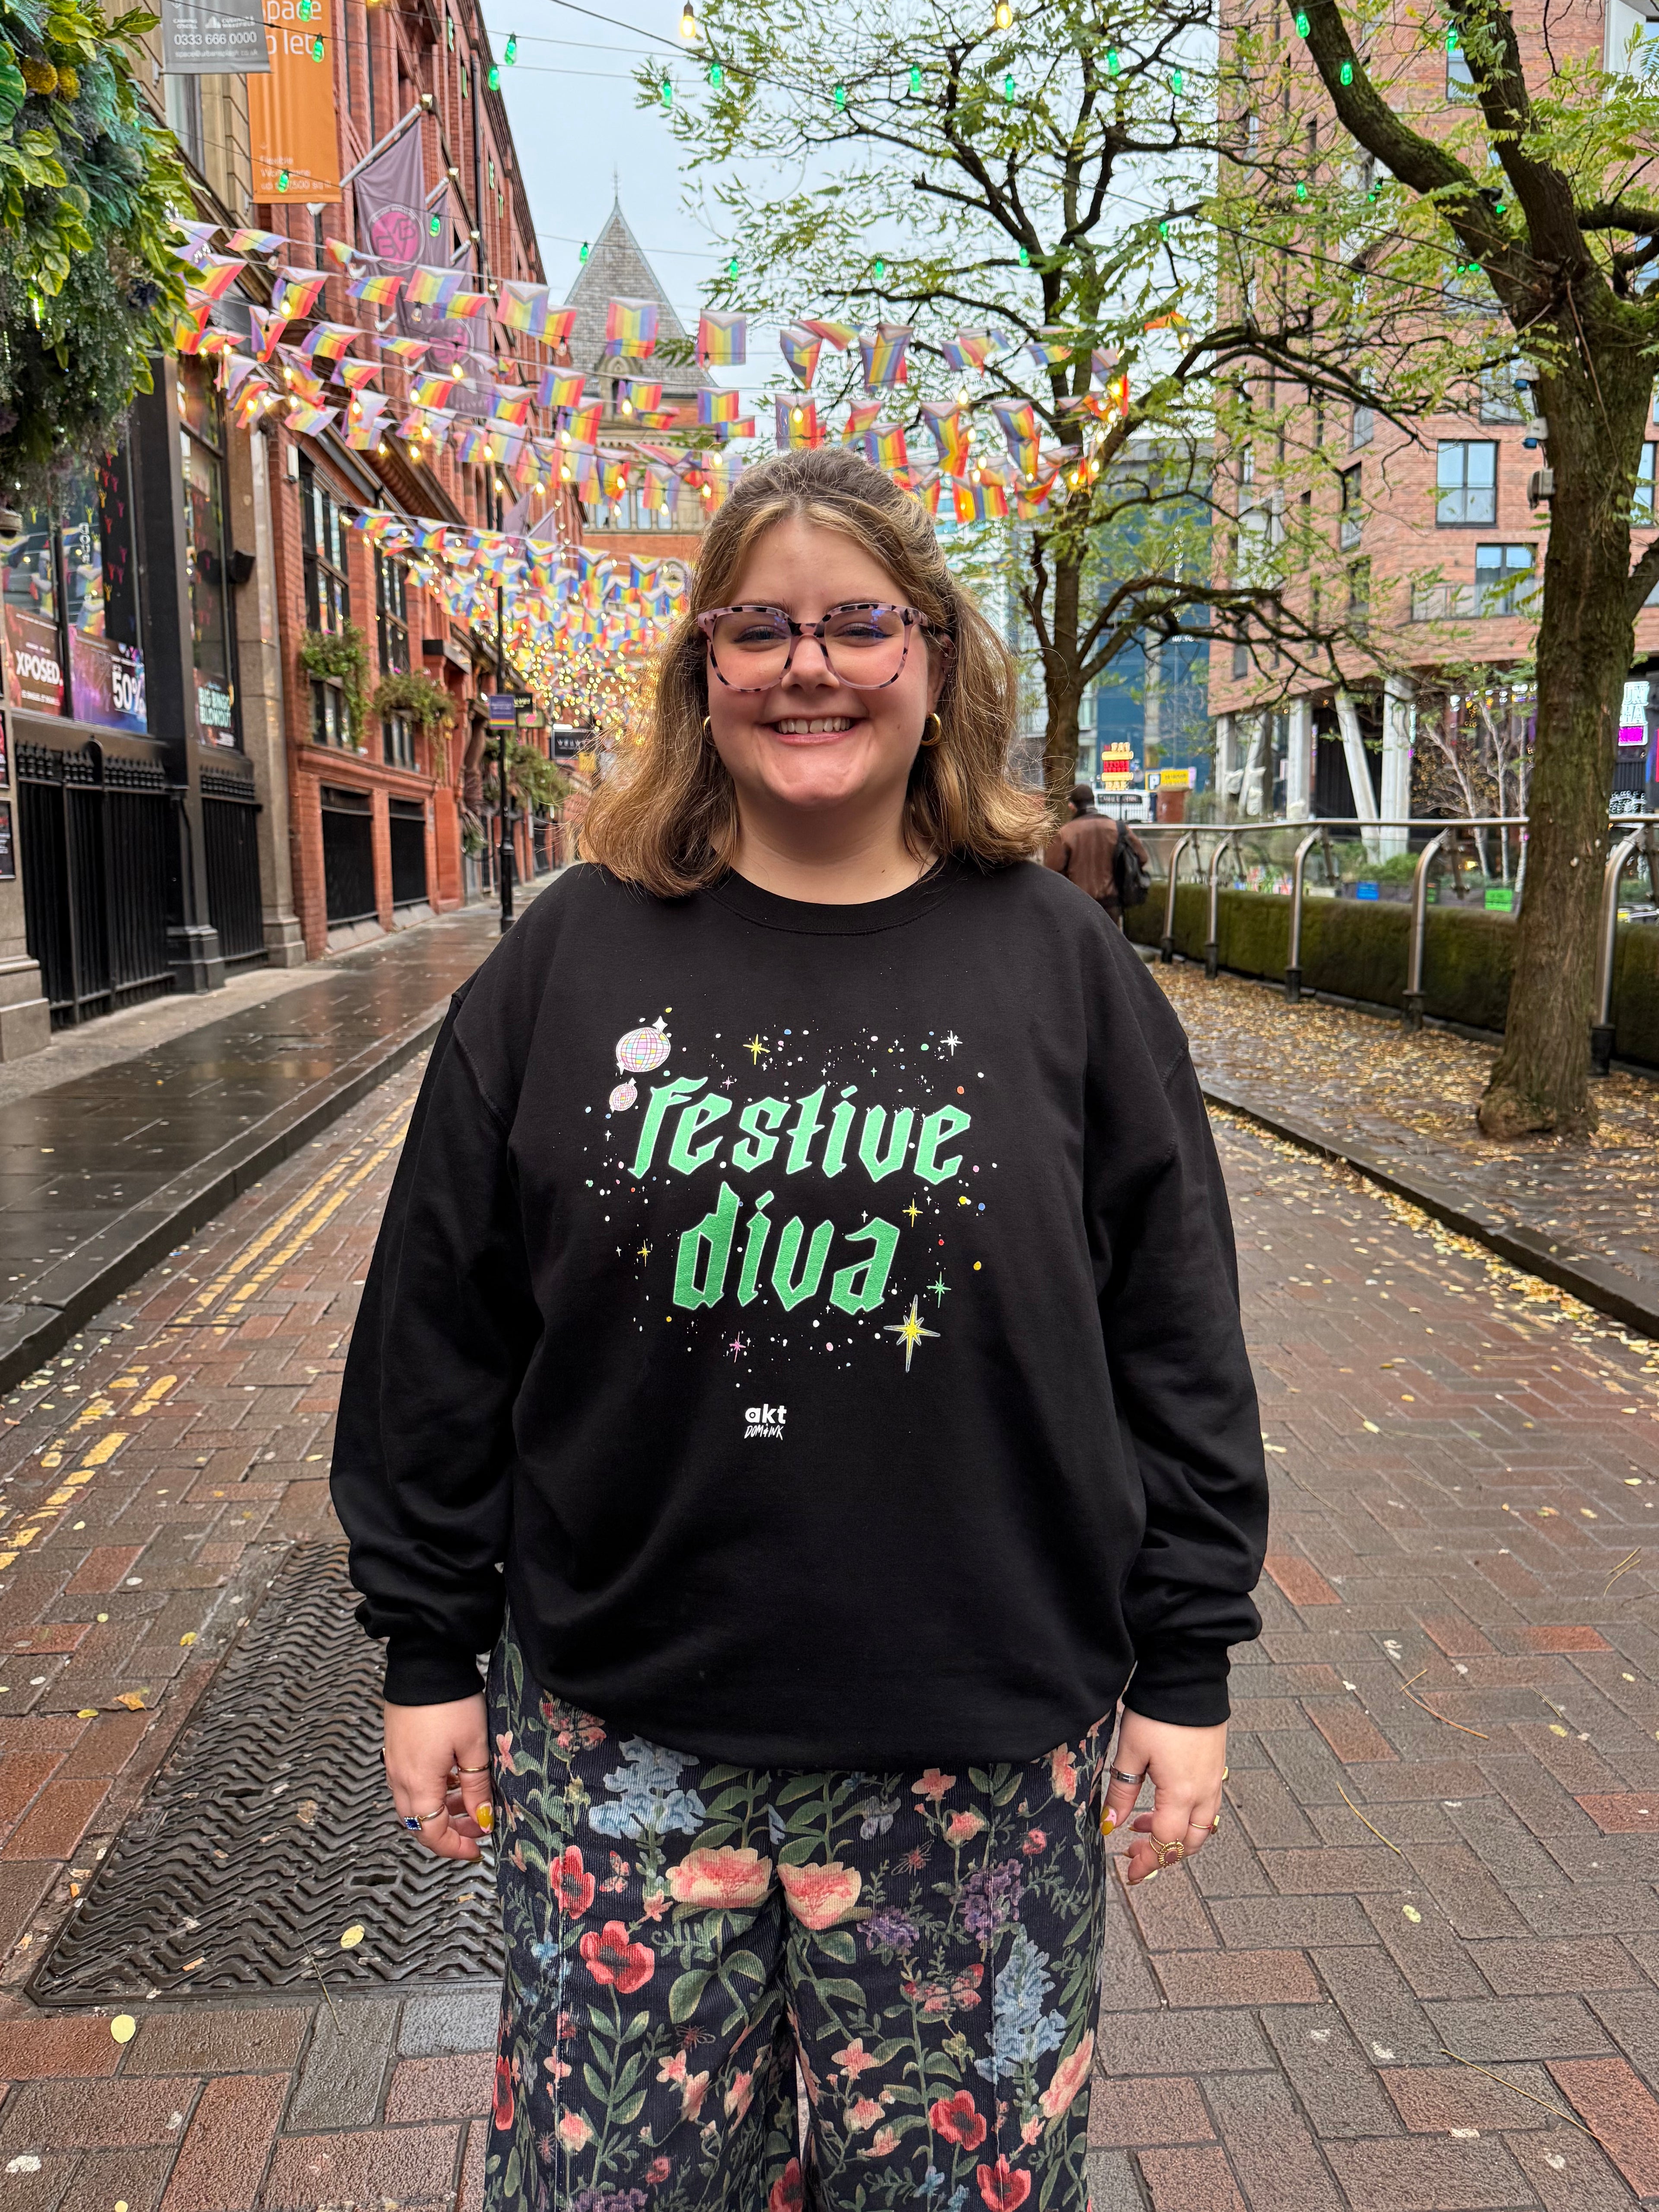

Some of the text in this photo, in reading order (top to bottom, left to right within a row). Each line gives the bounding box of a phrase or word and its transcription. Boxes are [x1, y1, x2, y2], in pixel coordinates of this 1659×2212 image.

[263, 0, 322, 25] pace
[174, 31, 257, 45] 0333 666 0000
[628, 1076, 971, 1185] festive
[672, 1181, 900, 1315] diva
[745, 1404, 787, 1424] akt
